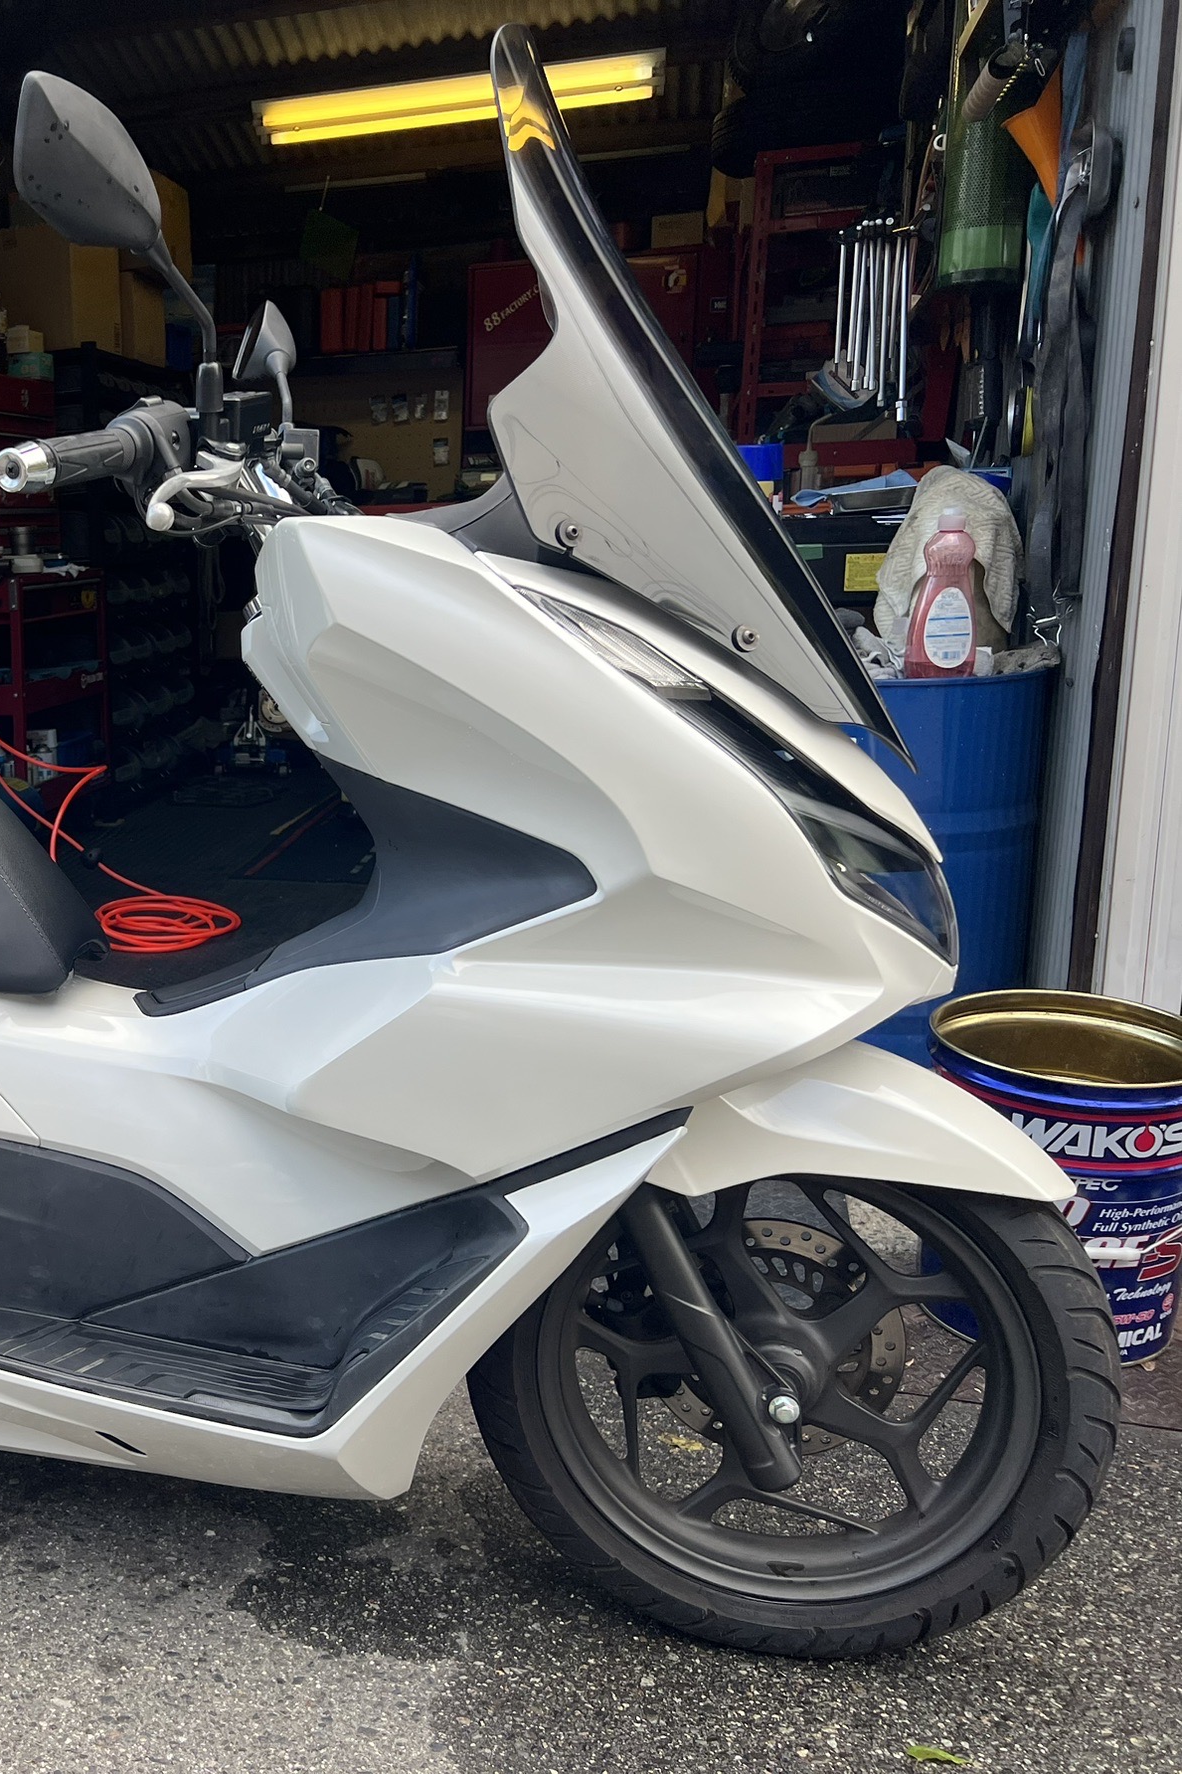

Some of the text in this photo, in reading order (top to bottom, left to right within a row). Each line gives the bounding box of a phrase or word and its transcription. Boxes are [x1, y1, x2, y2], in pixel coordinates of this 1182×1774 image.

[1012, 1112, 1182, 1159] WAKO'S
[1071, 1176, 1122, 1192] PEC
[1092, 1222, 1119, 1232] Full
[1119, 1216, 1170, 1235] Synthetic
[1113, 1281, 1172, 1302] Technology
